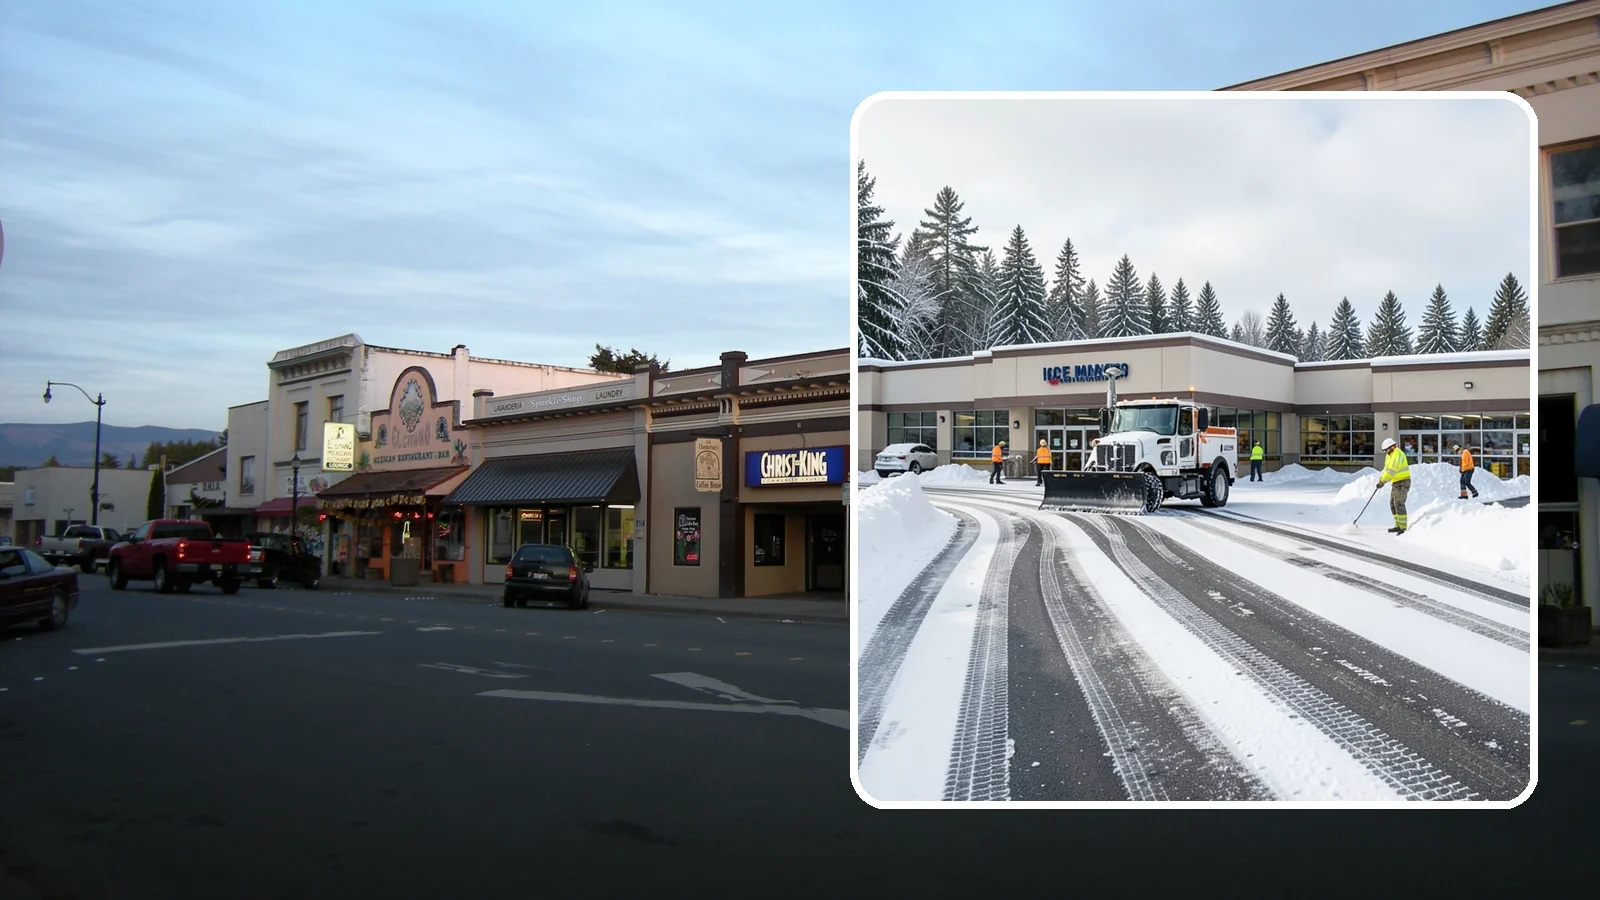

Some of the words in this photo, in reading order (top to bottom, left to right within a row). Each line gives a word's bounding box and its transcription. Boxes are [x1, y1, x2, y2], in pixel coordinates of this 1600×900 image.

[531, 398, 560, 409] Sparkle
[562, 394, 582, 406] Shop
[595, 389, 623, 400] LAUNDRY
[493, 402, 522, 412] LAVANDERIA
[373, 454, 396, 464] MEXICAN
[397, 451, 433, 463] RESTAURANT
[438, 450, 450, 459] BAR
[761, 452, 797, 478] CHRIST
[799, 450, 827, 476] KING
